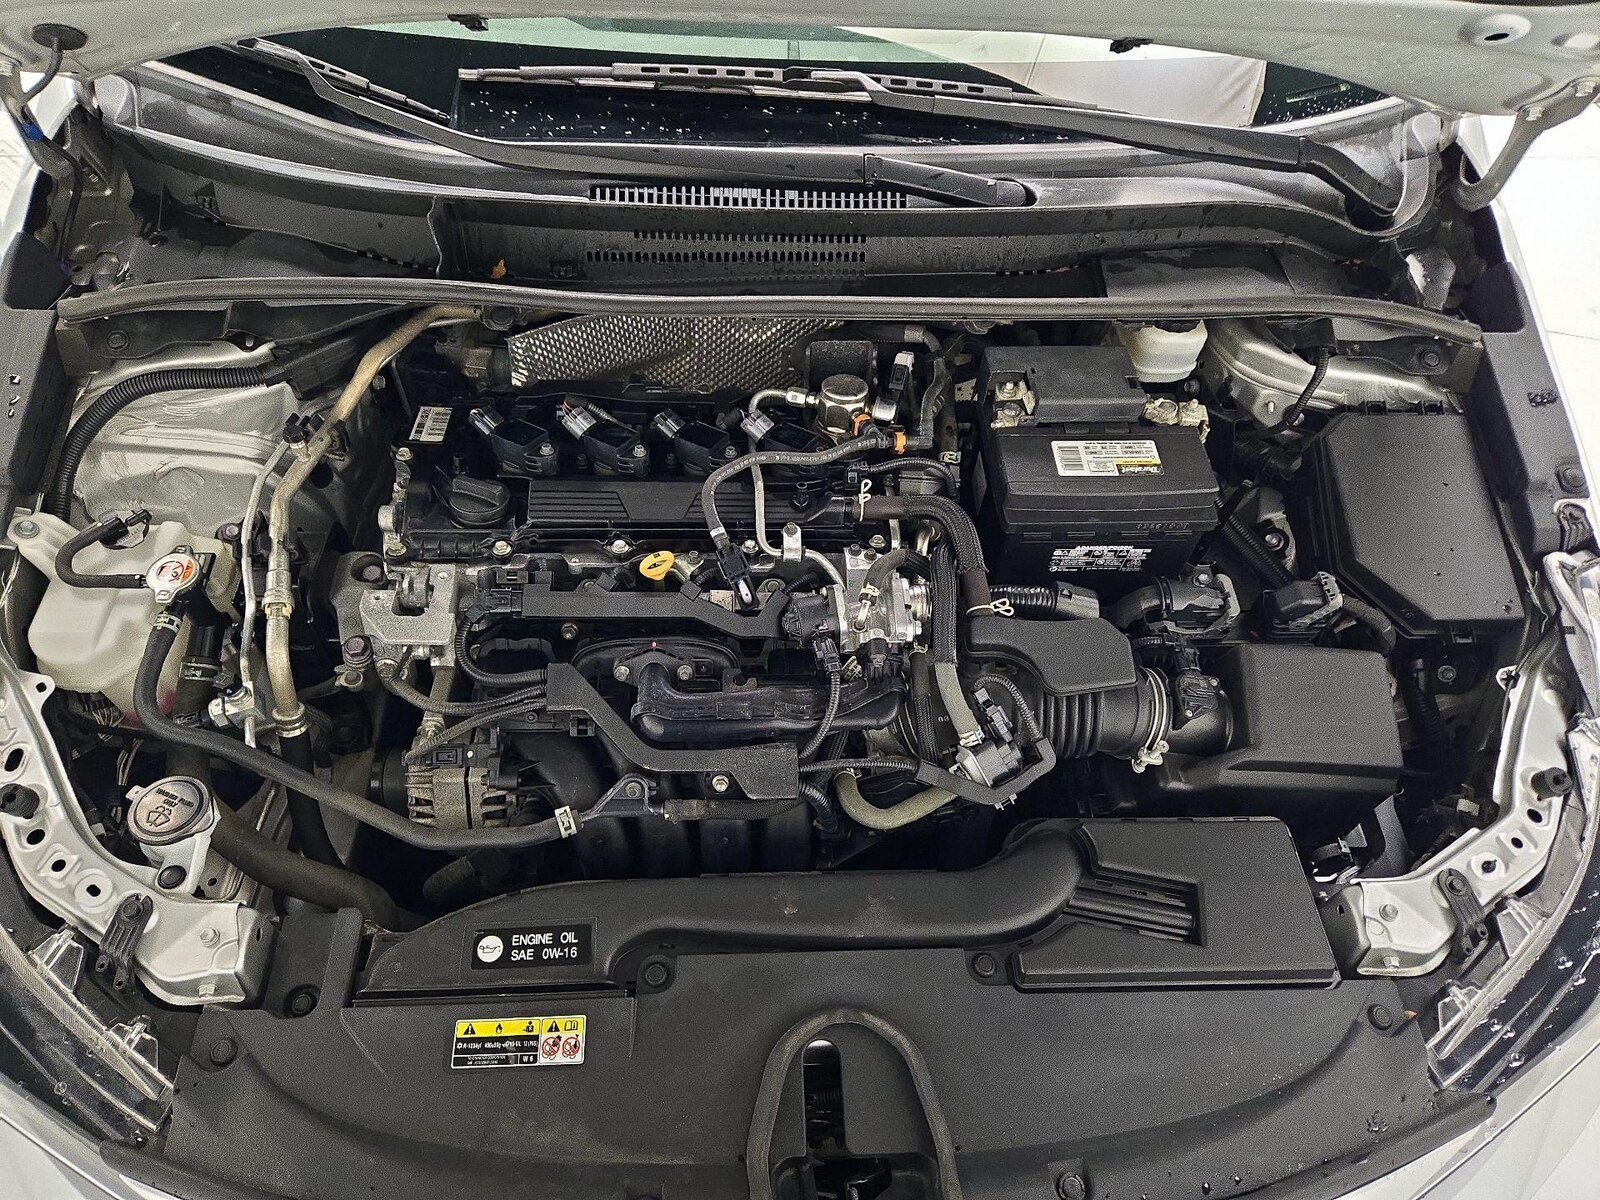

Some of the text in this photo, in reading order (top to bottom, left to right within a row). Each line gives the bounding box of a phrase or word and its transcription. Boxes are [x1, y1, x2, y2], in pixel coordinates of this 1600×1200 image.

[511, 931, 579, 946] ENGINE OIL
[511, 947, 578, 961] SAE 0W-16
